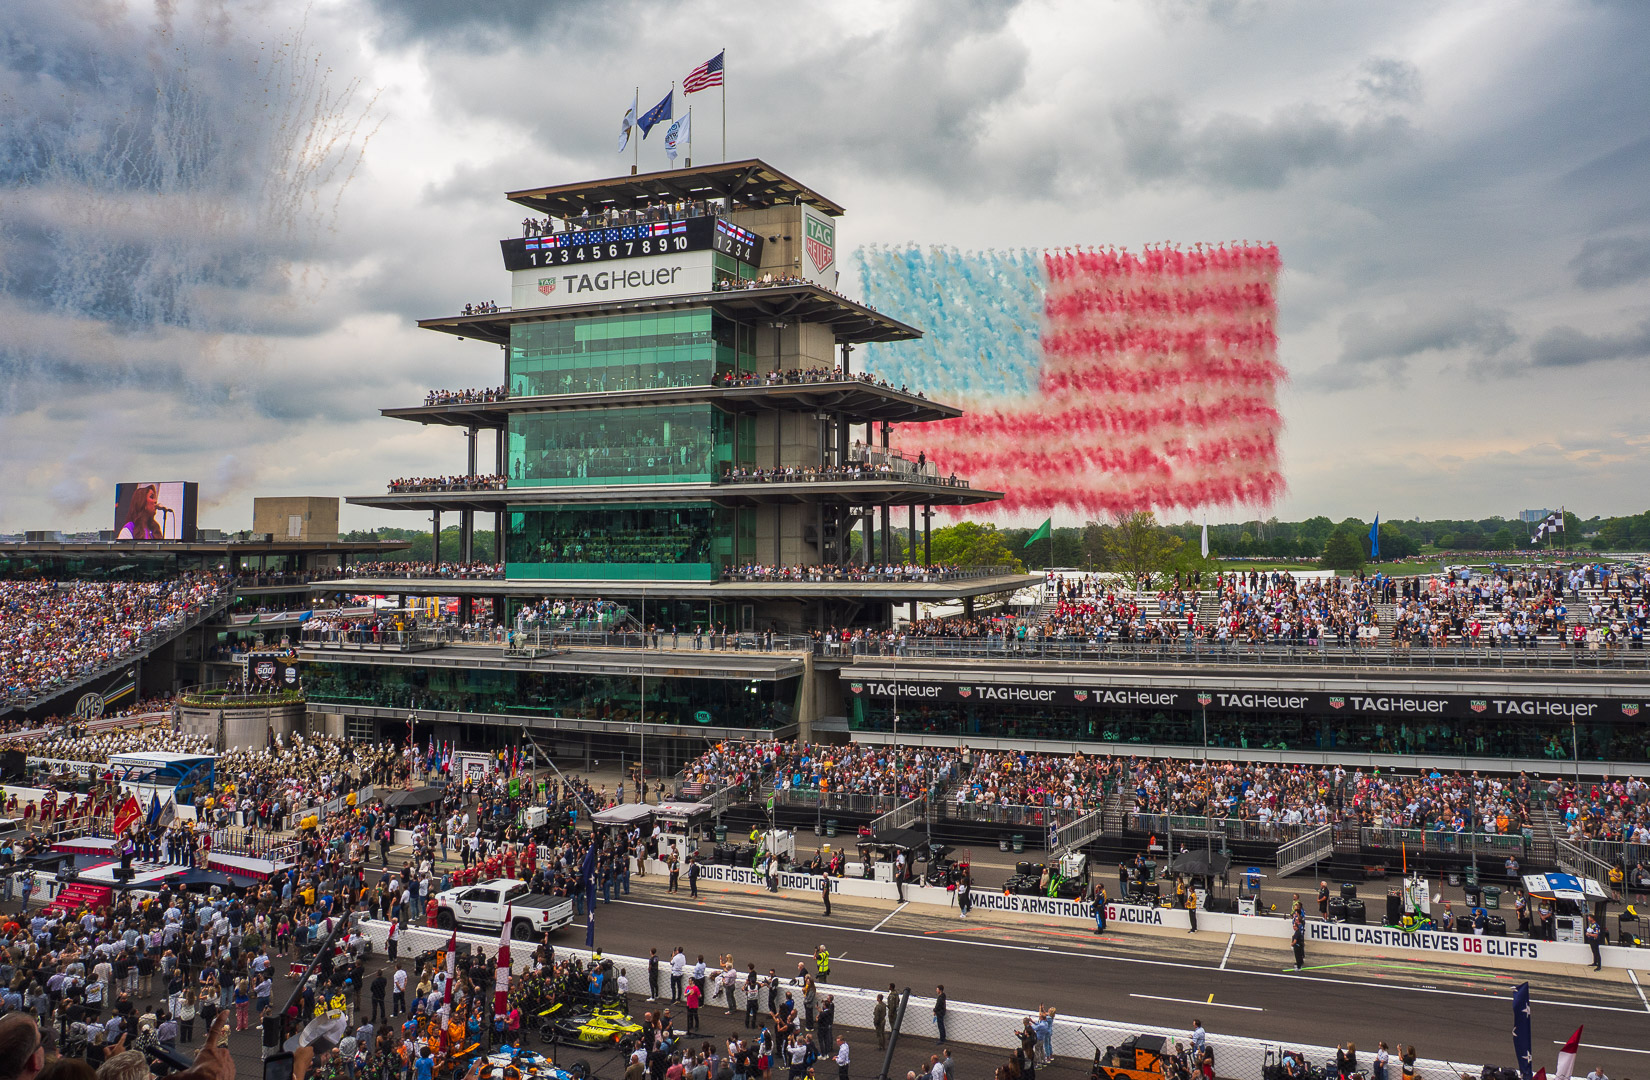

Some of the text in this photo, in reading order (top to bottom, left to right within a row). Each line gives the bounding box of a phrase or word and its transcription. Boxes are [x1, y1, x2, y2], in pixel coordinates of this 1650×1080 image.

[808, 219, 831, 244] TAG
[530, 236, 688, 265] 1 2 3 4 5 6 7 8 9 10
[717, 235, 751, 260] 1 2 3 4
[807, 238, 832, 268] HEUER
[539, 278, 555, 286] TAG
[700, 865, 723, 880] OUIS
[726, 868, 764, 885] FOSTER
[969, 893, 1018, 911] MARCUS
[1119, 908, 1162, 925] ACURA
[1311, 924, 1538, 958] HELIO CASTRONEVES 06 CLIFFS
